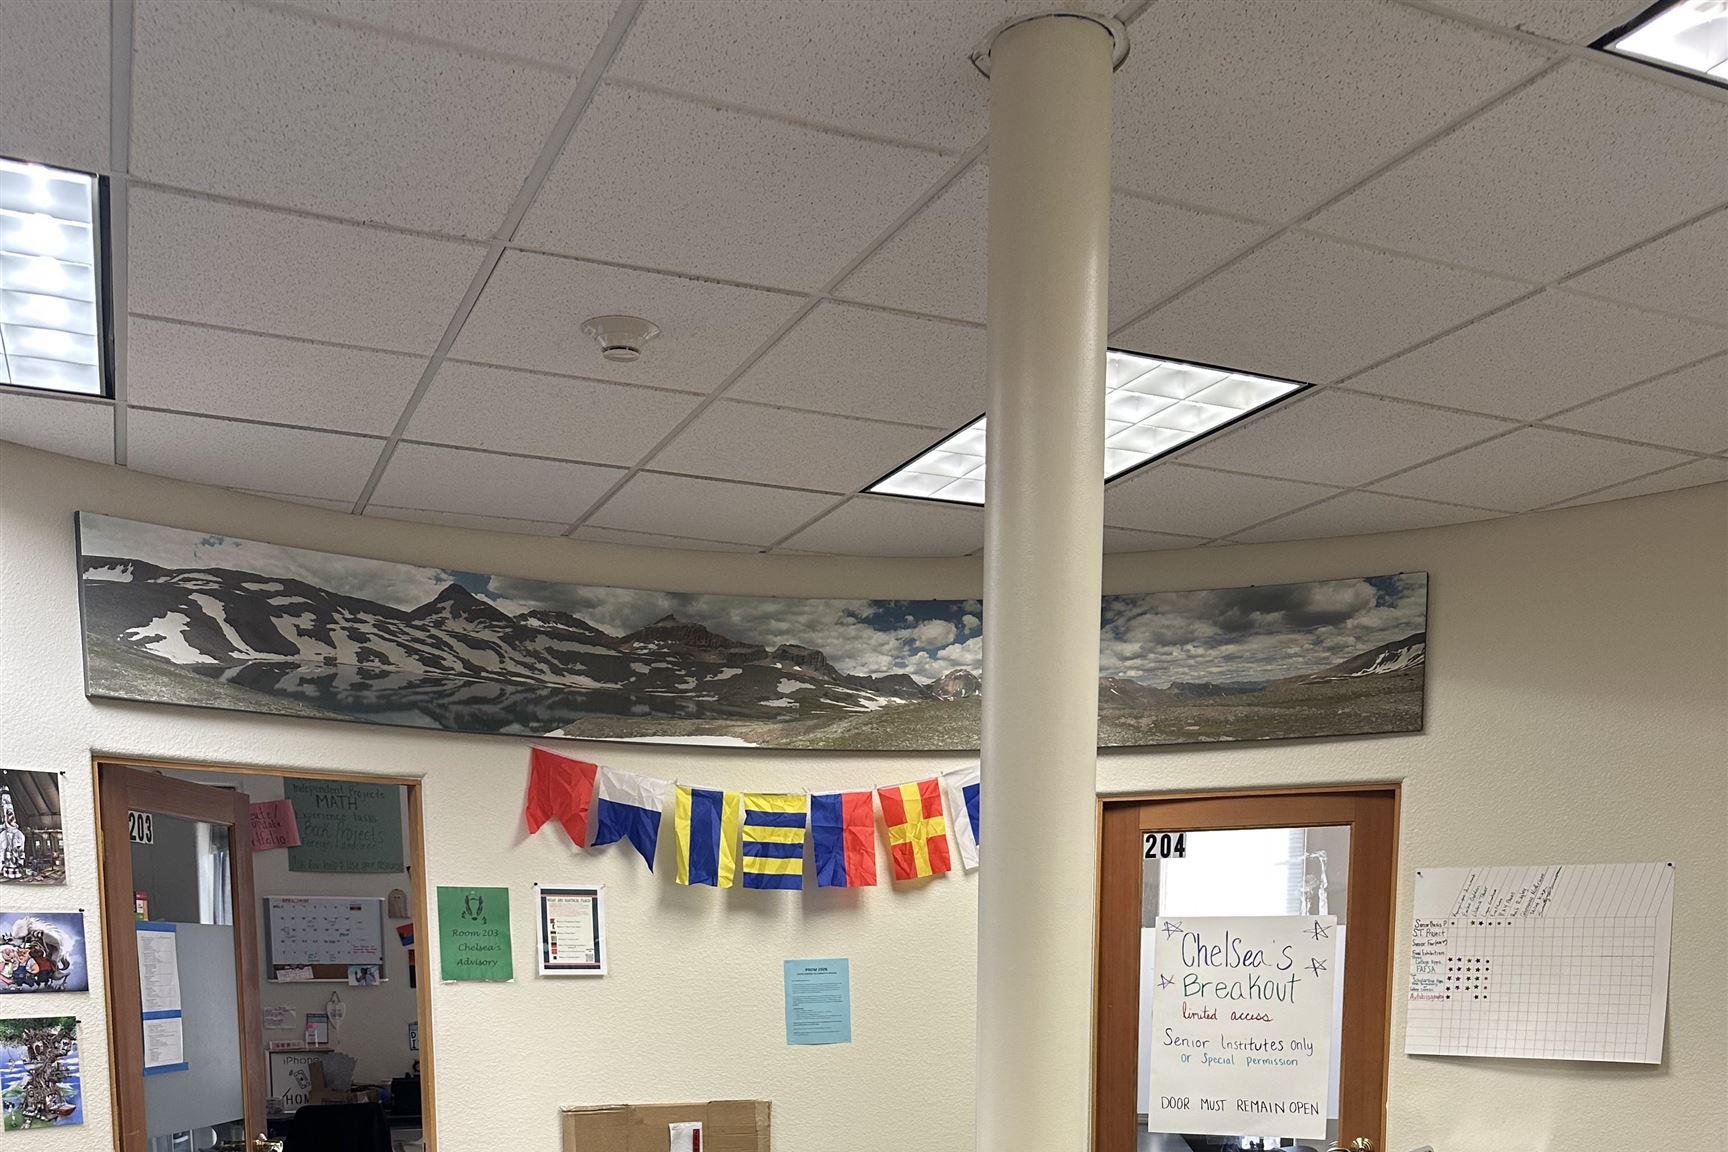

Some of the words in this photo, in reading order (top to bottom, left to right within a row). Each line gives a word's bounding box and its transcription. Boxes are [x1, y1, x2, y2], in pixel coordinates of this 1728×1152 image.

[315, 794, 359, 810] MATH
[129, 812, 152, 843] 203
[336, 821, 385, 844] Projects
[1145, 834, 1185, 858] 204
[452, 929, 480, 937] Room
[482, 929, 499, 937] 203
[458, 943, 502, 951] Chelsea's
[457, 957, 498, 967] Advisory
[1183, 973, 1302, 1004] Breakout
[1182, 1001, 1217, 1020] limited
[1230, 1010, 1274, 1021] access
[1163, 1027, 1210, 1048] Senior
[1221, 1033, 1284, 1052] Institutes
[1201, 1052, 1235, 1067] Special
[1246, 1056, 1298, 1067] permission
[1161, 1096, 1190, 1110] DOOR
[1200, 1098, 1227, 1112] MUST
[1236, 1099, 1285, 1114] REMAIN
[1289, 1101, 1319, 1115] OPEN
